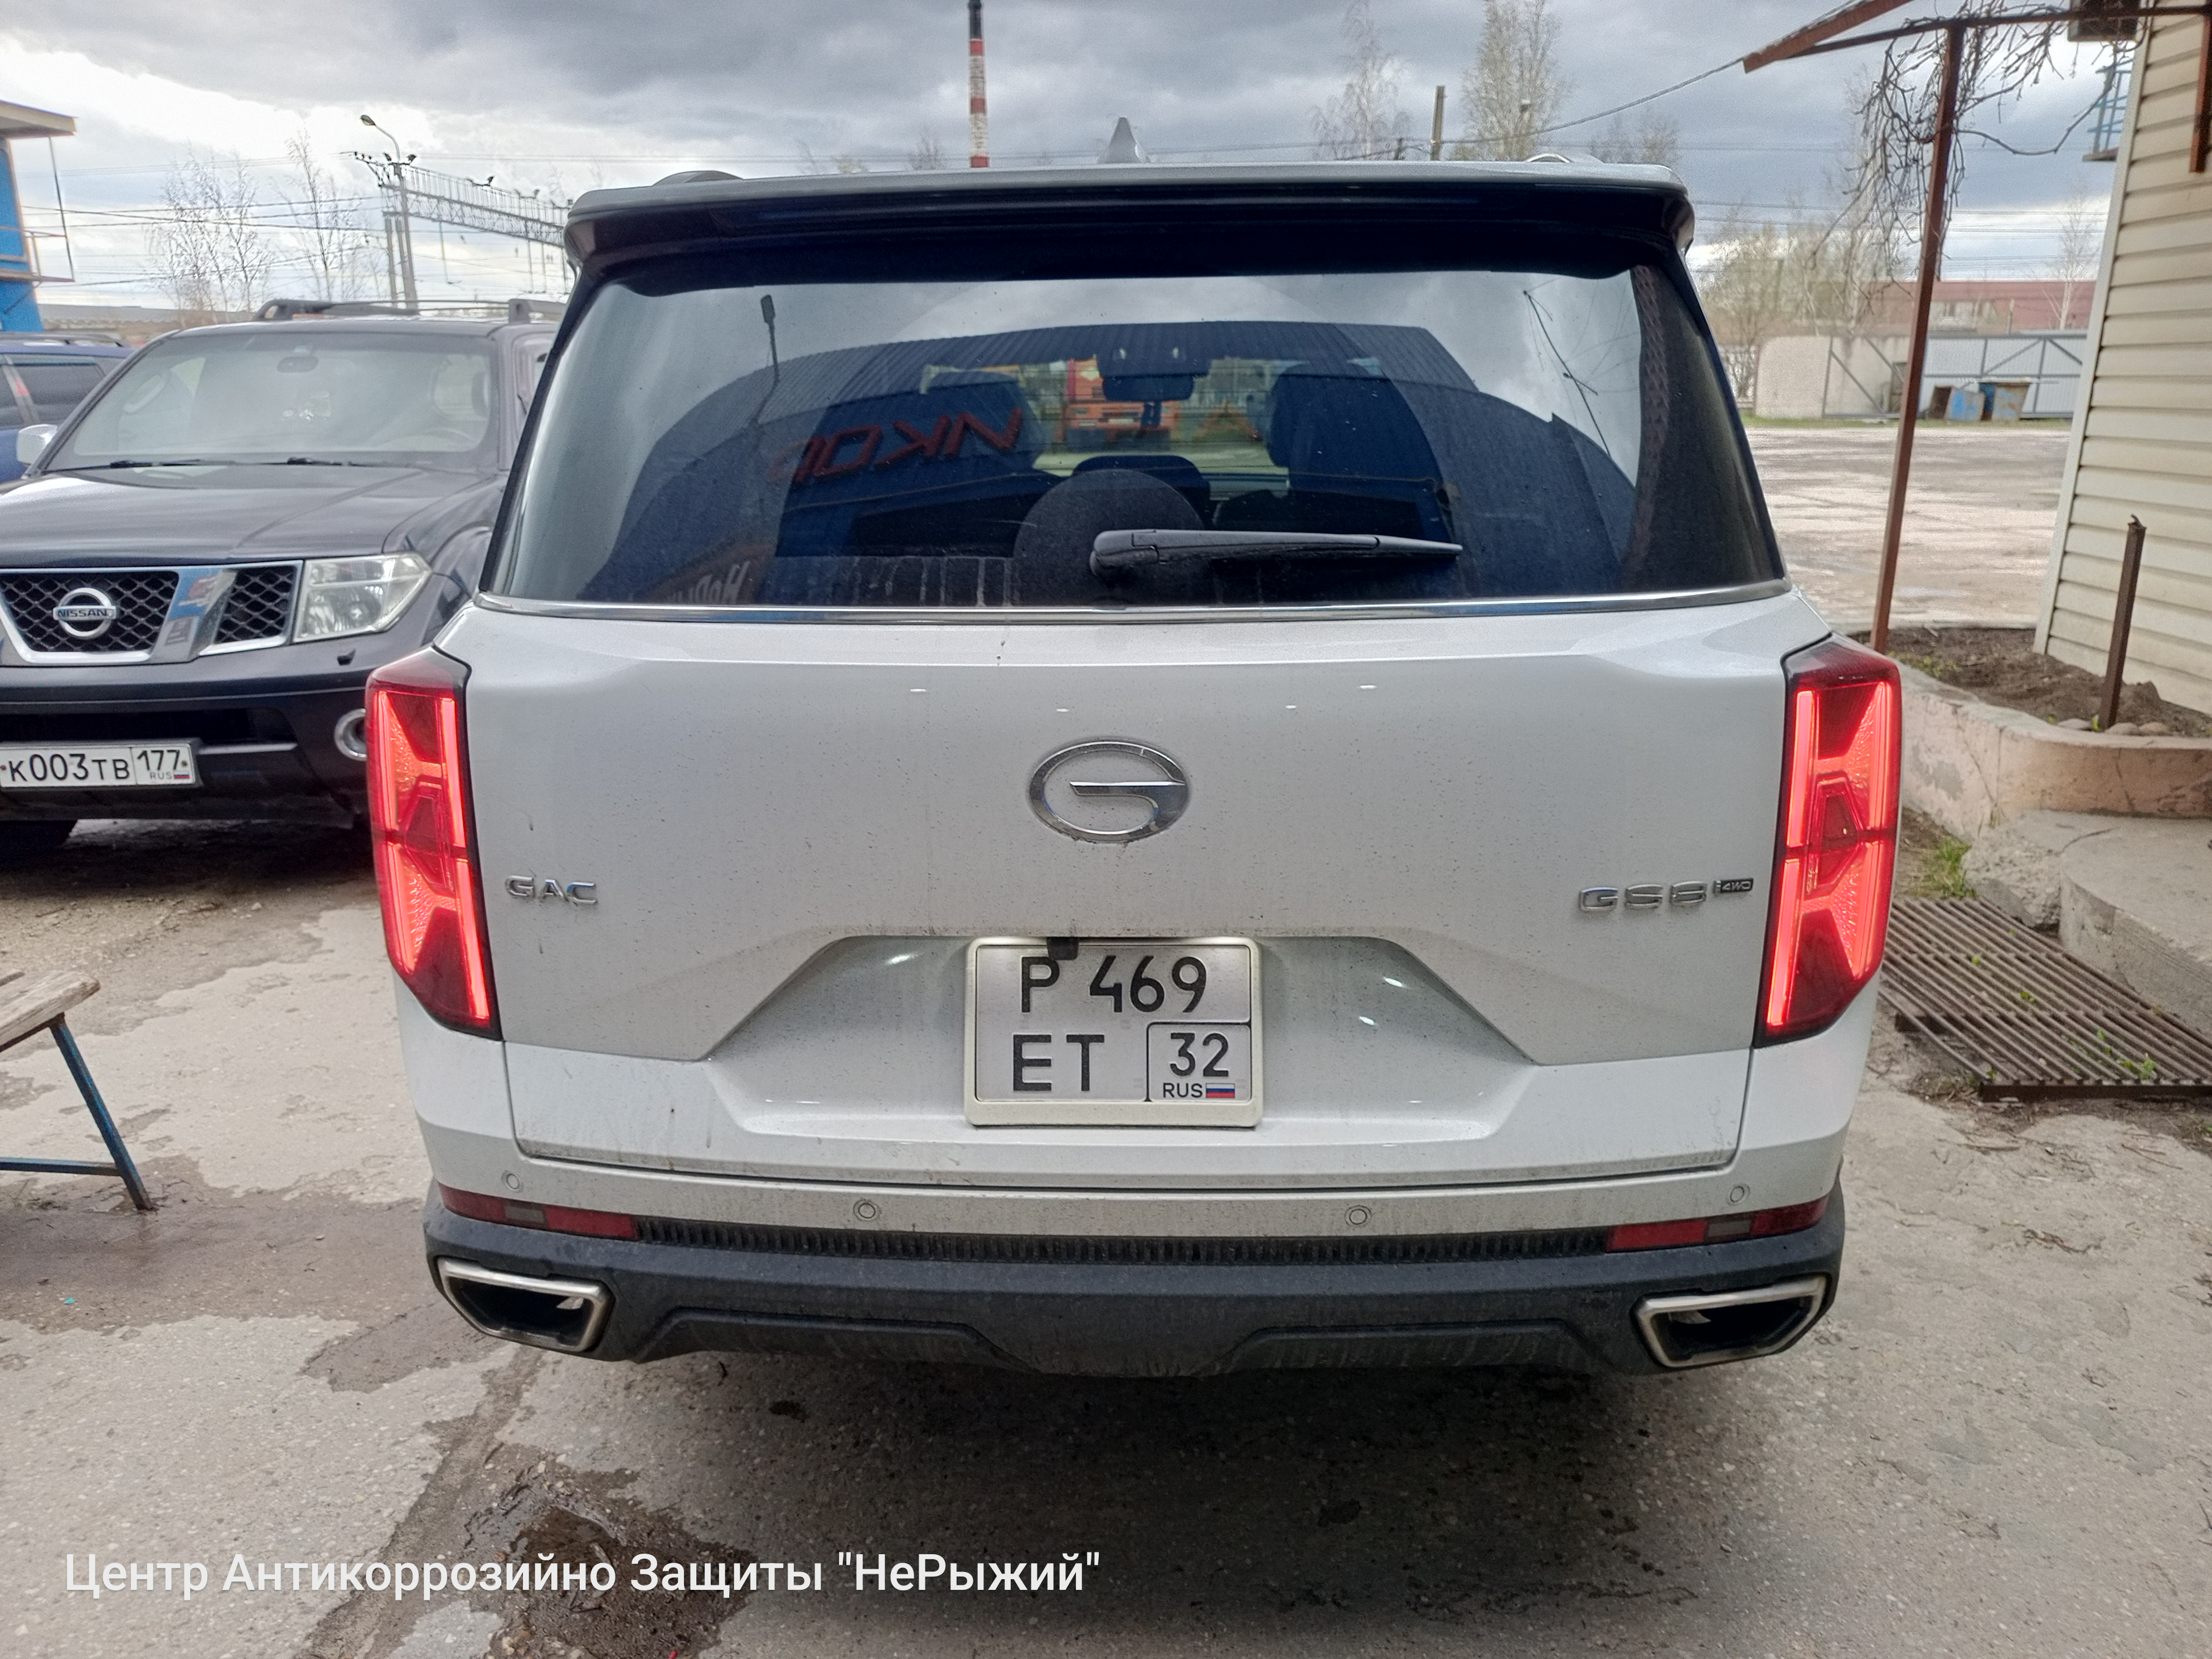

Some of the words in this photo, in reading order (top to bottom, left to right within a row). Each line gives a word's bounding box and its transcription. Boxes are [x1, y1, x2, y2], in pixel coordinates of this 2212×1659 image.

[58, 608, 108, 617] NISSAN
[137, 749, 180, 771] 177
[150, 772, 172, 780] RUS
[505, 875, 598, 905] GAC
[1089, 955, 1207, 1013] 469
[1169, 1032, 1230, 1078] 32
[1162, 1082, 1203, 1098] RUS
